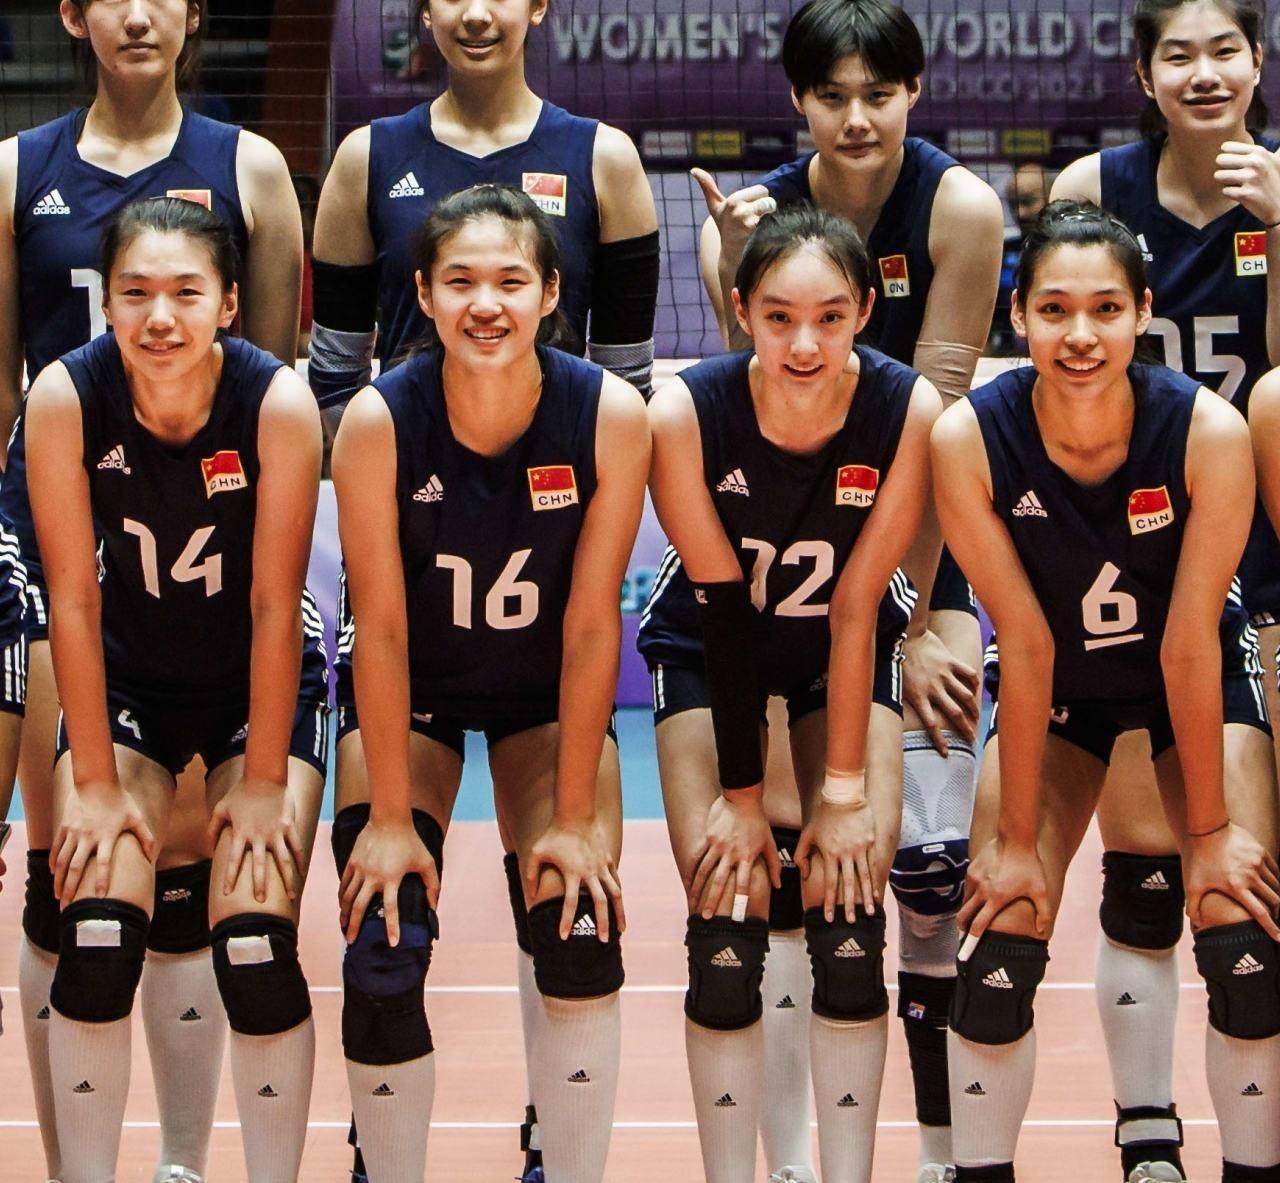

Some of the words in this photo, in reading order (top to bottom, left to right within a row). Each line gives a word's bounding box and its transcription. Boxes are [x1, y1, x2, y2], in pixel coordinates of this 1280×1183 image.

[553, 12, 780, 61] WOMEN'S
[389, 186, 424, 198] adidas
[33, 204, 70, 215] adidas
[535, 200, 560, 211] HN
[1242, 260, 1267, 272] CH
[209, 475, 241, 491] CHN
[539, 492, 572, 507] CHN
[842, 491, 875, 504] CHN
[1012, 505, 1048, 518] adidas
[1136, 513, 1169, 529] CHN
[123, 518, 222, 599] 14
[741, 537, 833, 618] 12
[436, 549, 539, 631] 16
[1082, 561, 1139, 636] 6
[571, 927, 598, 937] adida
[834, 948, 866, 958] adidas
[711, 957, 742, 969] adidas
[1232, 963, 1264, 975] adidas
[982, 978, 1014, 989] adidas
